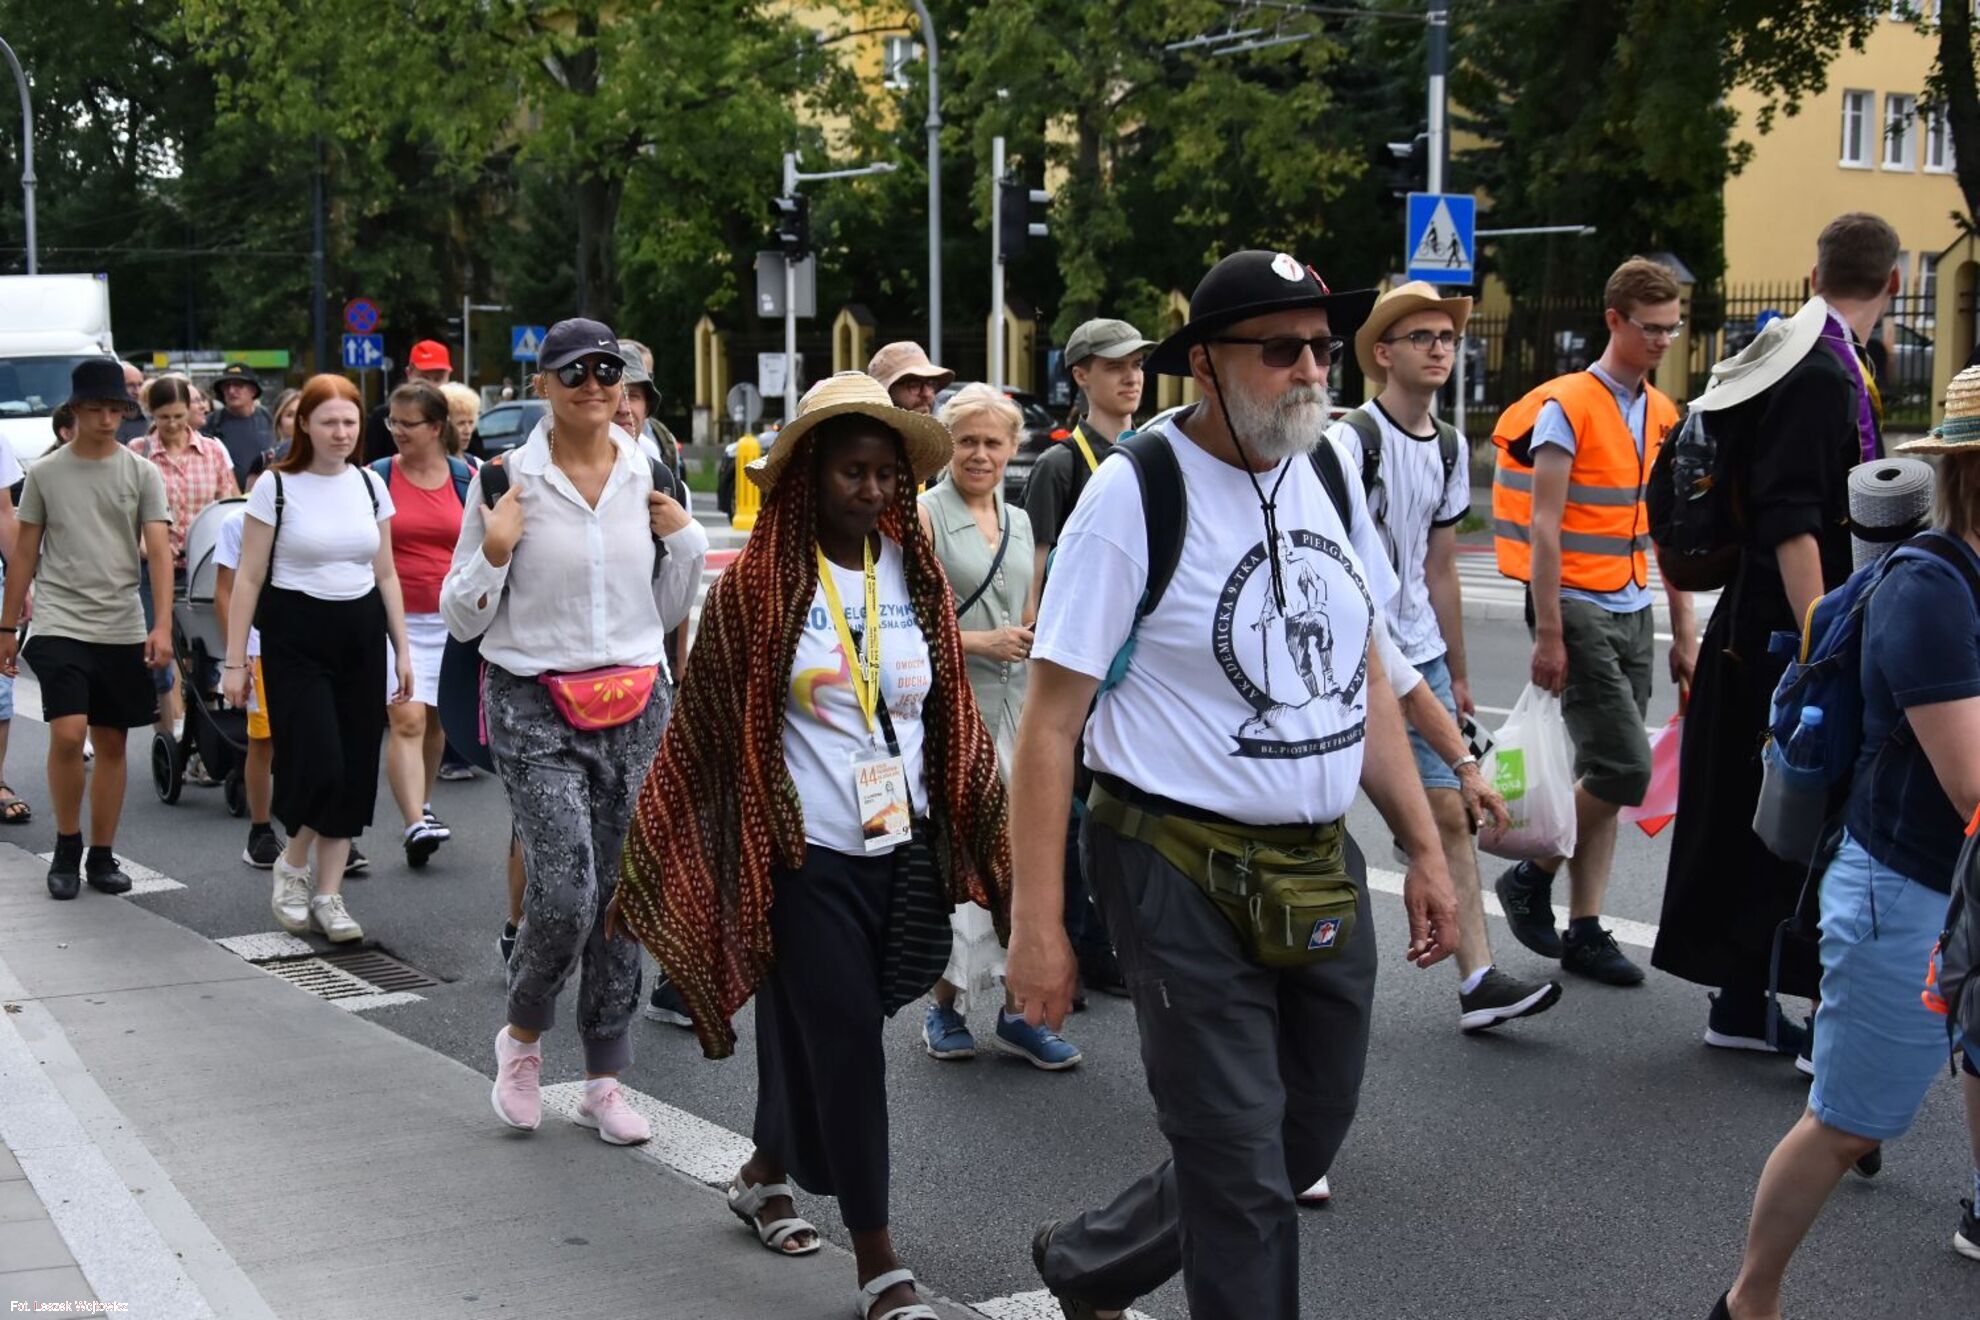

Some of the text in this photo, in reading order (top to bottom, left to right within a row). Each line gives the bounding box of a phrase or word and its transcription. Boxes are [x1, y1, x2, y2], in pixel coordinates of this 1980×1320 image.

[1226, 555, 1260, 594] 9-TKA
[1217, 601, 1260, 699] AKADEMICKA
[860, 767, 878, 787] 44
